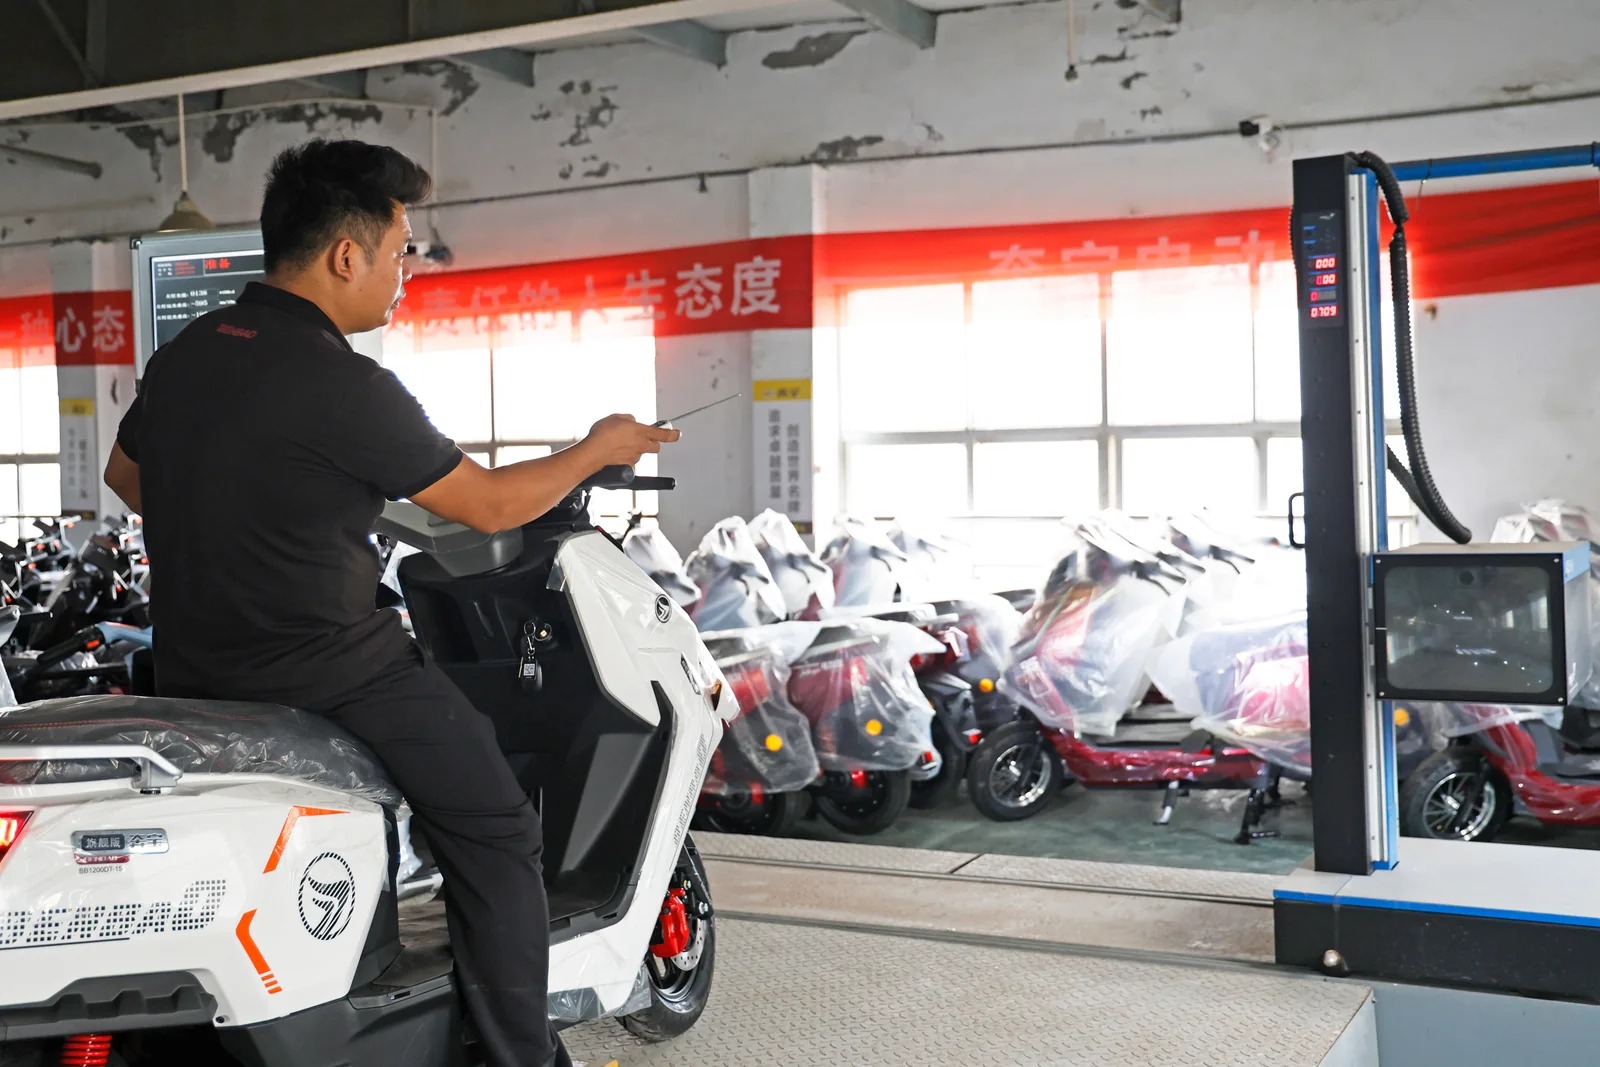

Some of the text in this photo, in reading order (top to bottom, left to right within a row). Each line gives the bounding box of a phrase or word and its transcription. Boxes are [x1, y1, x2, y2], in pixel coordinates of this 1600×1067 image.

[85, 837, 120, 848] 旗舰版
[79, 866, 122, 875] BB1200DT-15
